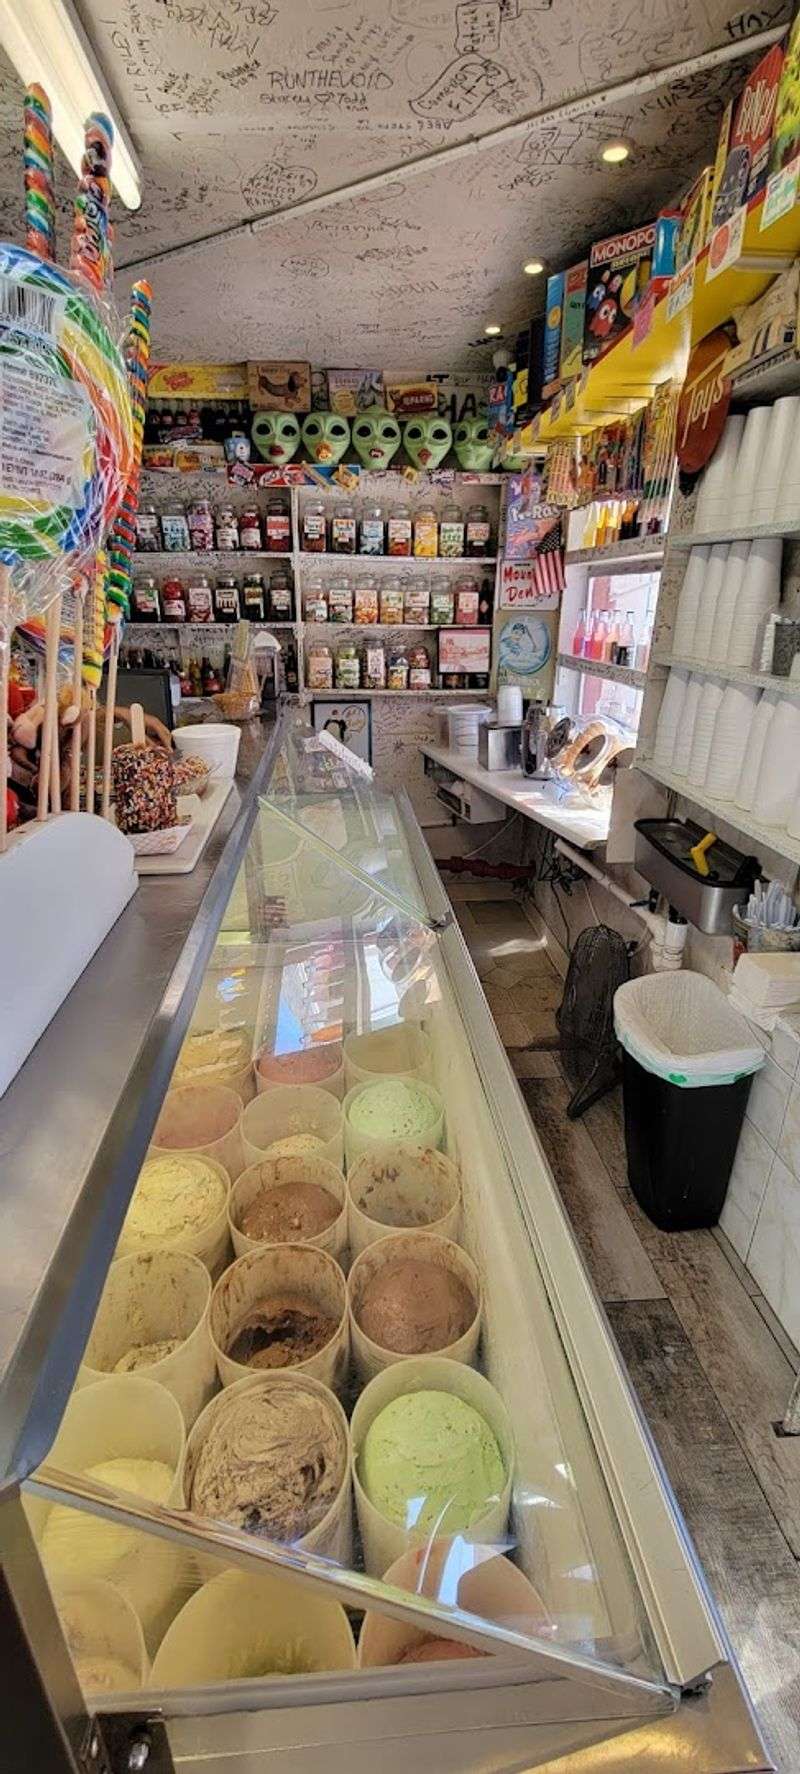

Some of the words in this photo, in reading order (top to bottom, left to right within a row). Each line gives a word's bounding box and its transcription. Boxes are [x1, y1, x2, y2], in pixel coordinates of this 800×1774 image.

[594, 228, 656, 263] MONOPO
[681, 375, 724, 449] Toys
[503, 566, 535, 583] Moun
